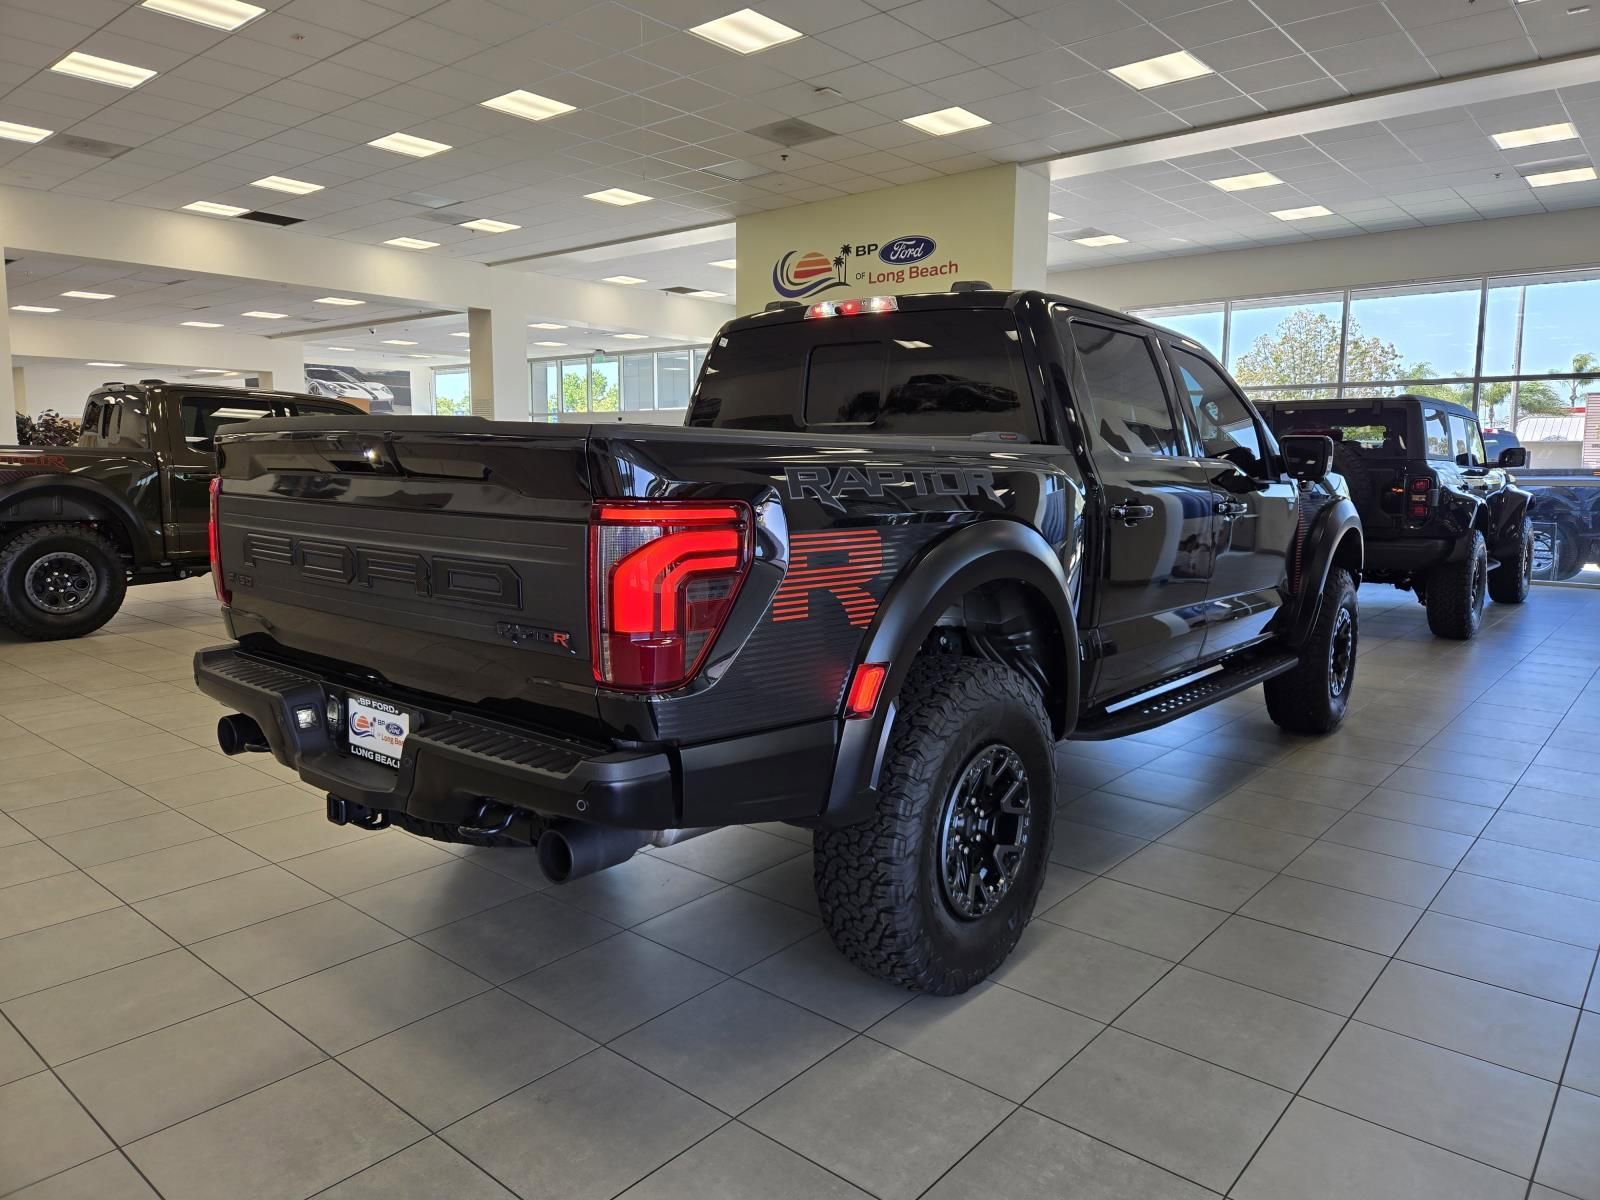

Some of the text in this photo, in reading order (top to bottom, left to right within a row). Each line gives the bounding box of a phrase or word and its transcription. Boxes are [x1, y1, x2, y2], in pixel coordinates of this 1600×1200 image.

[856, 240, 924, 260] BP Ford
[868, 268, 905, 285] Long
[909, 260, 958, 280] Beach
[784, 466, 1006, 513] RAPTOR
[243, 532, 524, 610] FORD
[360, 698, 394, 713] BP FORD
[351, 746, 373, 759] LONG
